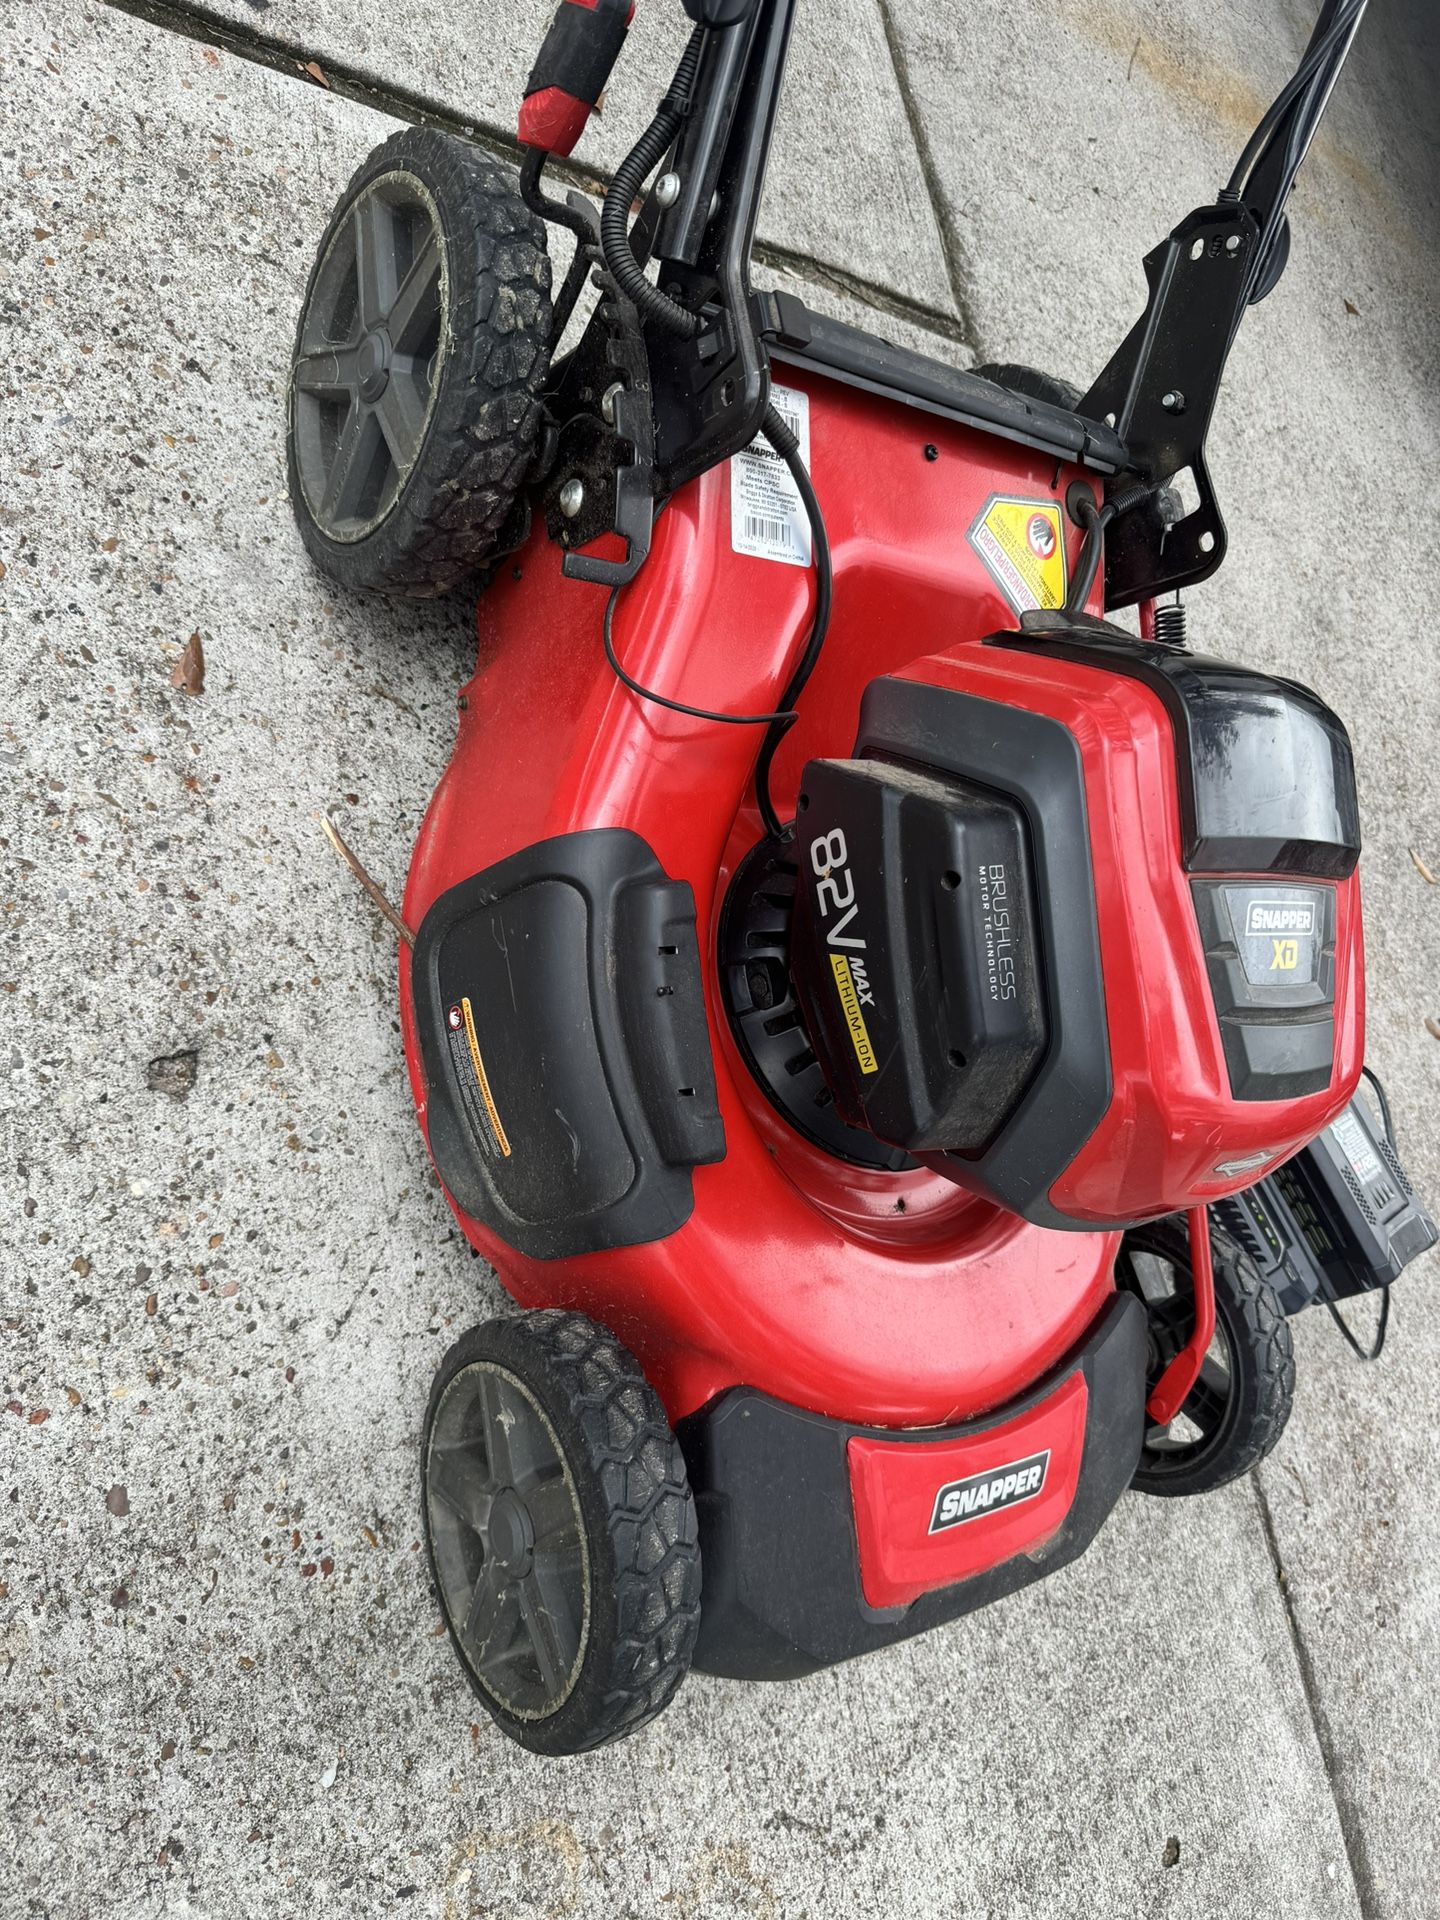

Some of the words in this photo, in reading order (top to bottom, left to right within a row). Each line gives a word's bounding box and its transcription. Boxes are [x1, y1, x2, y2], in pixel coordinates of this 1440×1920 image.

[740, 459, 791, 477] WWW.SNAPPER.C
[811, 828, 867, 948] 82V
[978, 865, 990, 910] MOTOR
[984, 917, 999, 1001] TECHNOLOGY
[989, 864, 1016, 1000] BRUSHLESS
[1251, 907, 1311, 929] SNAPPER
[848, 957, 875, 1006] MAX
[1269, 939, 1298, 970] XD
[835, 960, 873, 1068] LITHIUM-ION
[939, 1464, 1042, 1521] SNAPPER
